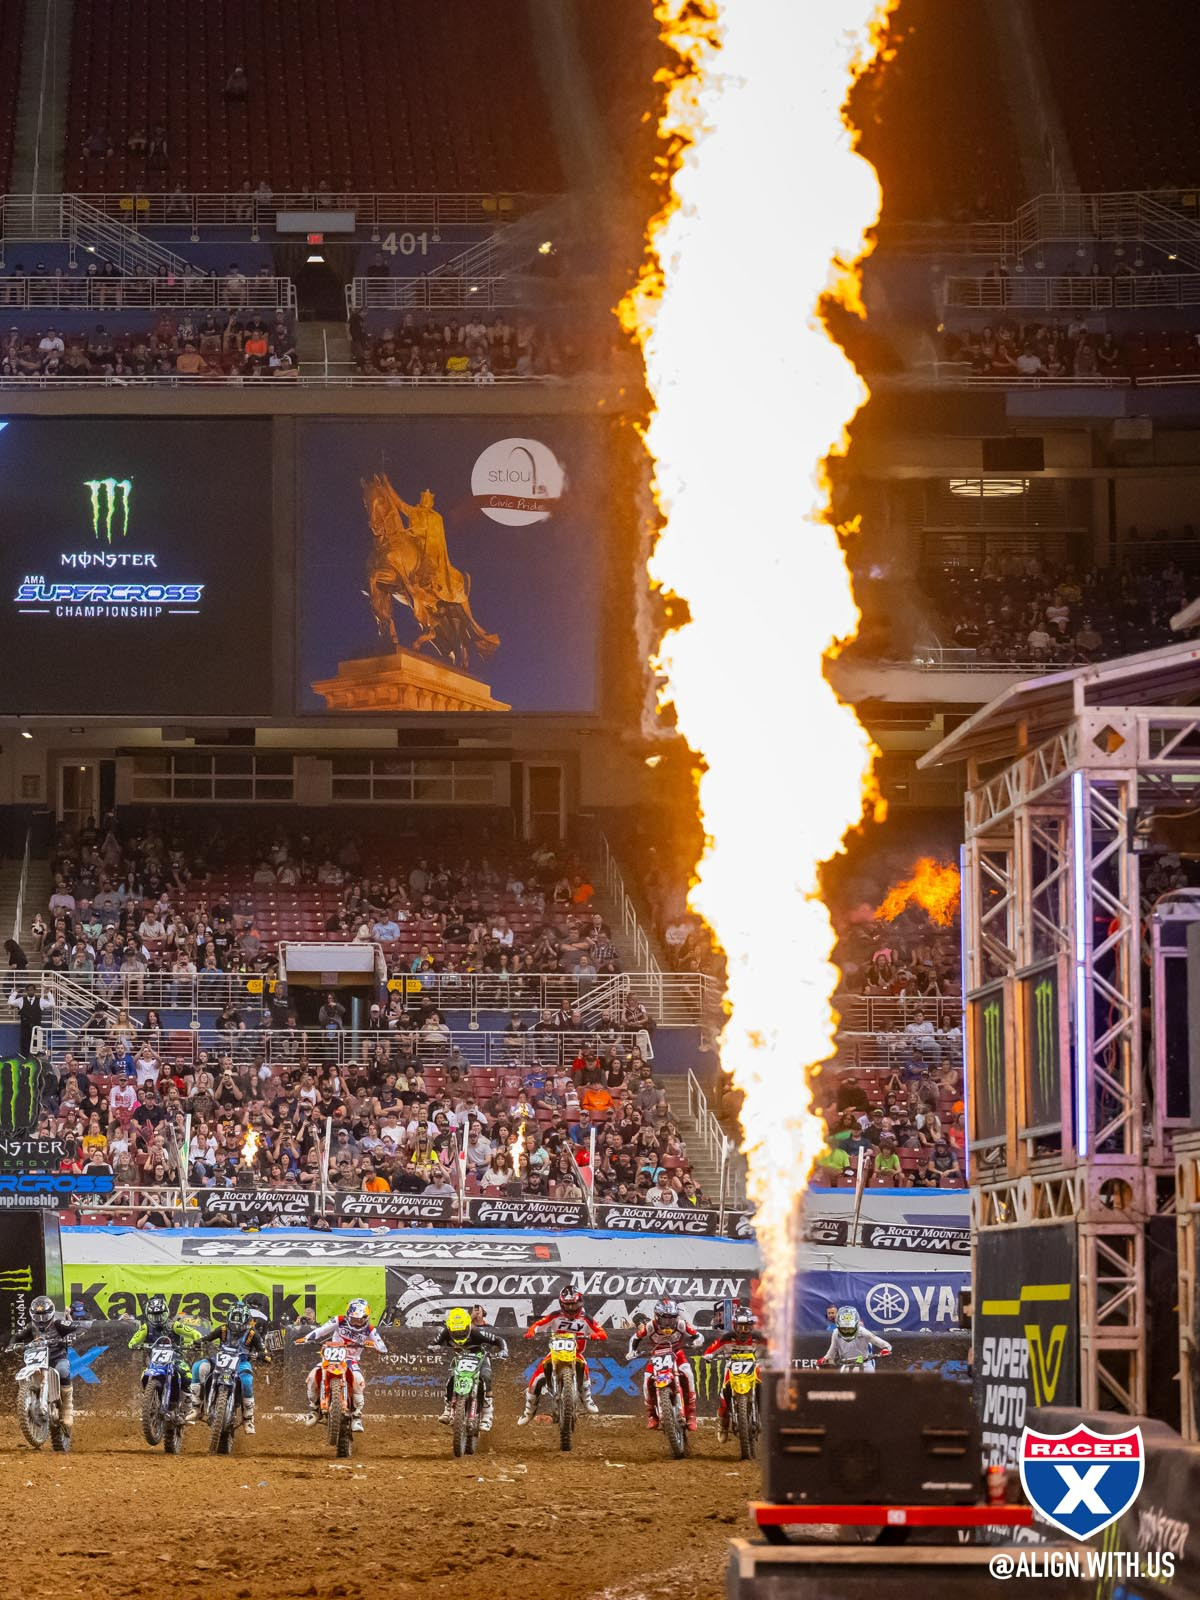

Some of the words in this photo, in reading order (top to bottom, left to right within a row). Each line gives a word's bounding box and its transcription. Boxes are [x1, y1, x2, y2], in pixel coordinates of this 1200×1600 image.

[382, 232, 428, 255] 401
[490, 496, 513, 508] Civic
[517, 499, 545, 511] Pride
[62, 552, 157, 568] MONSTER
[24, 576, 45, 584] AMA
[14, 584, 204, 602] SUPERCROSS
[56, 607, 162, 617] CHAMPIONSHIP
[223, 1192, 254, 1200] ROCKY
[256, 1192, 308, 1201] MOUNTAIN
[359, 1195, 389, 1203] ROCKY
[391, 1196, 443, 1206] MOUNTAIN
[494, 1202, 526, 1211] ROCKY
[527, 1203, 580, 1213] MOUNTAIN
[622, 1208, 654, 1217] ROCKY
[656, 1210, 708, 1221] MOUNTAIN
[888, 1227, 920, 1236] ROCKY
[922, 1228, 971, 1239] MOUNTAI
[249, 1240, 350, 1249] ROCKY
[358, 1240, 530, 1252] MOUNTAIN
[450, 1271, 560, 1296] ROCKY
[570, 1272, 745, 1298] MOUNTAIN
[557, 1321, 584, 1332] FLY
[25, 1352, 47, 1364] 24
[151, 1349, 173, 1362] 73
[322, 1347, 347, 1360] 929
[982, 1337, 1029, 1379] SUPER
[216, 1354, 239, 1369] 31
[652, 1355, 672, 1369] 34
[730, 1361, 753, 1374] 87
[983, 1384, 1027, 1429] MOTO
